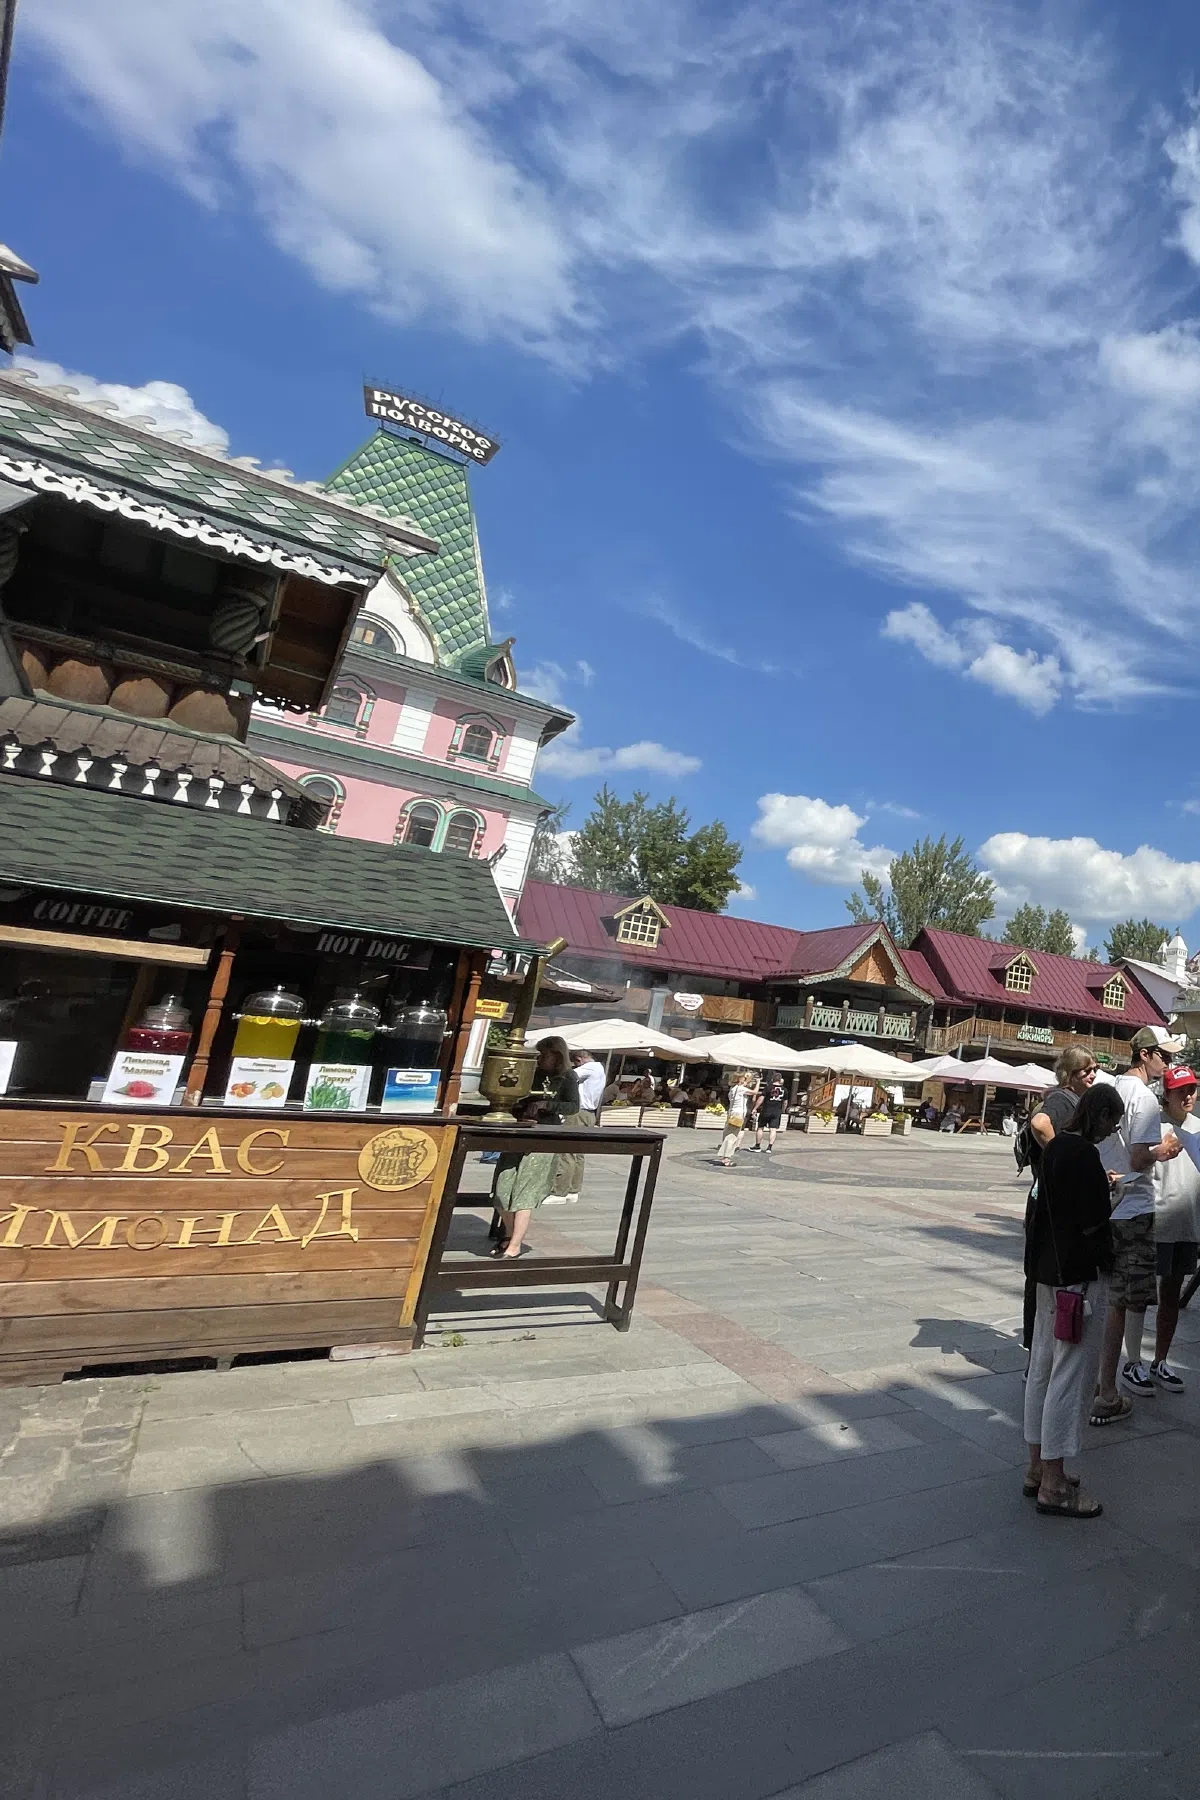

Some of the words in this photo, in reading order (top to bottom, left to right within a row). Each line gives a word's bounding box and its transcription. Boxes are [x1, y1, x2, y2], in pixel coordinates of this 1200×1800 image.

[371, 402, 486, 459] ПОДВОРЬЕ
[373, 390, 492, 449] РУССКОЕ
[32, 900, 134, 931] COFFEE
[315, 933, 364, 956] HOT
[364, 940, 412, 961] DOG
[122, 1056, 170, 1067] Лимонад
[318, 1065, 358, 1075] Лимонад
[44, 1121, 291, 1176] КВАС
